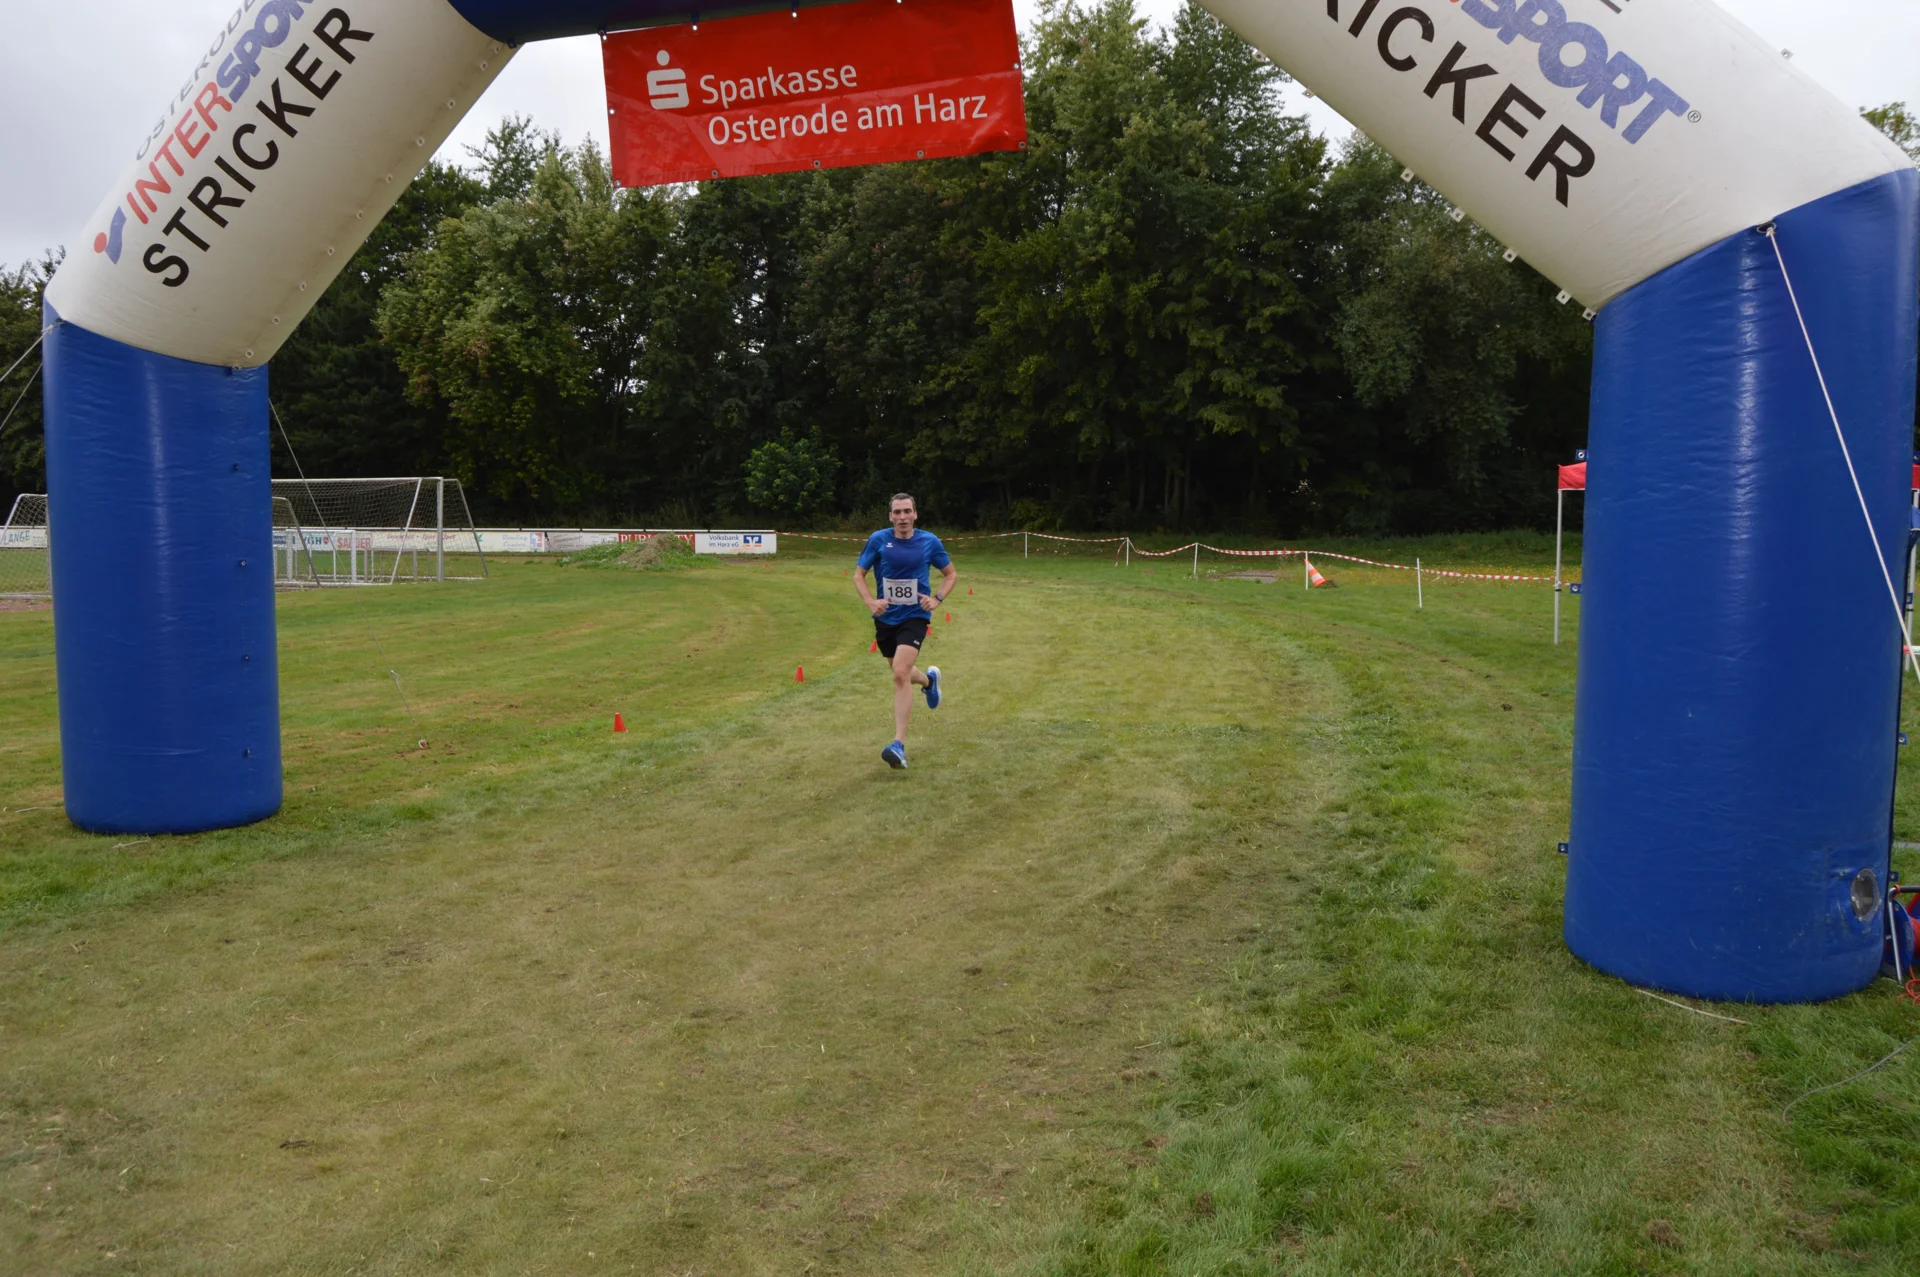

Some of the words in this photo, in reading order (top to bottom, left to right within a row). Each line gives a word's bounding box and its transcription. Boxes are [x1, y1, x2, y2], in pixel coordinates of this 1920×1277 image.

[699, 64, 857, 109] Sparkasse
[1450, 0, 1691, 145] SPORT
[707, 103, 848, 146] Osterode
[857, 103, 903, 131] am
[913, 92, 988, 124] Harz
[142, 7, 375, 288] STRICKER
[888, 586, 912, 599] 188
